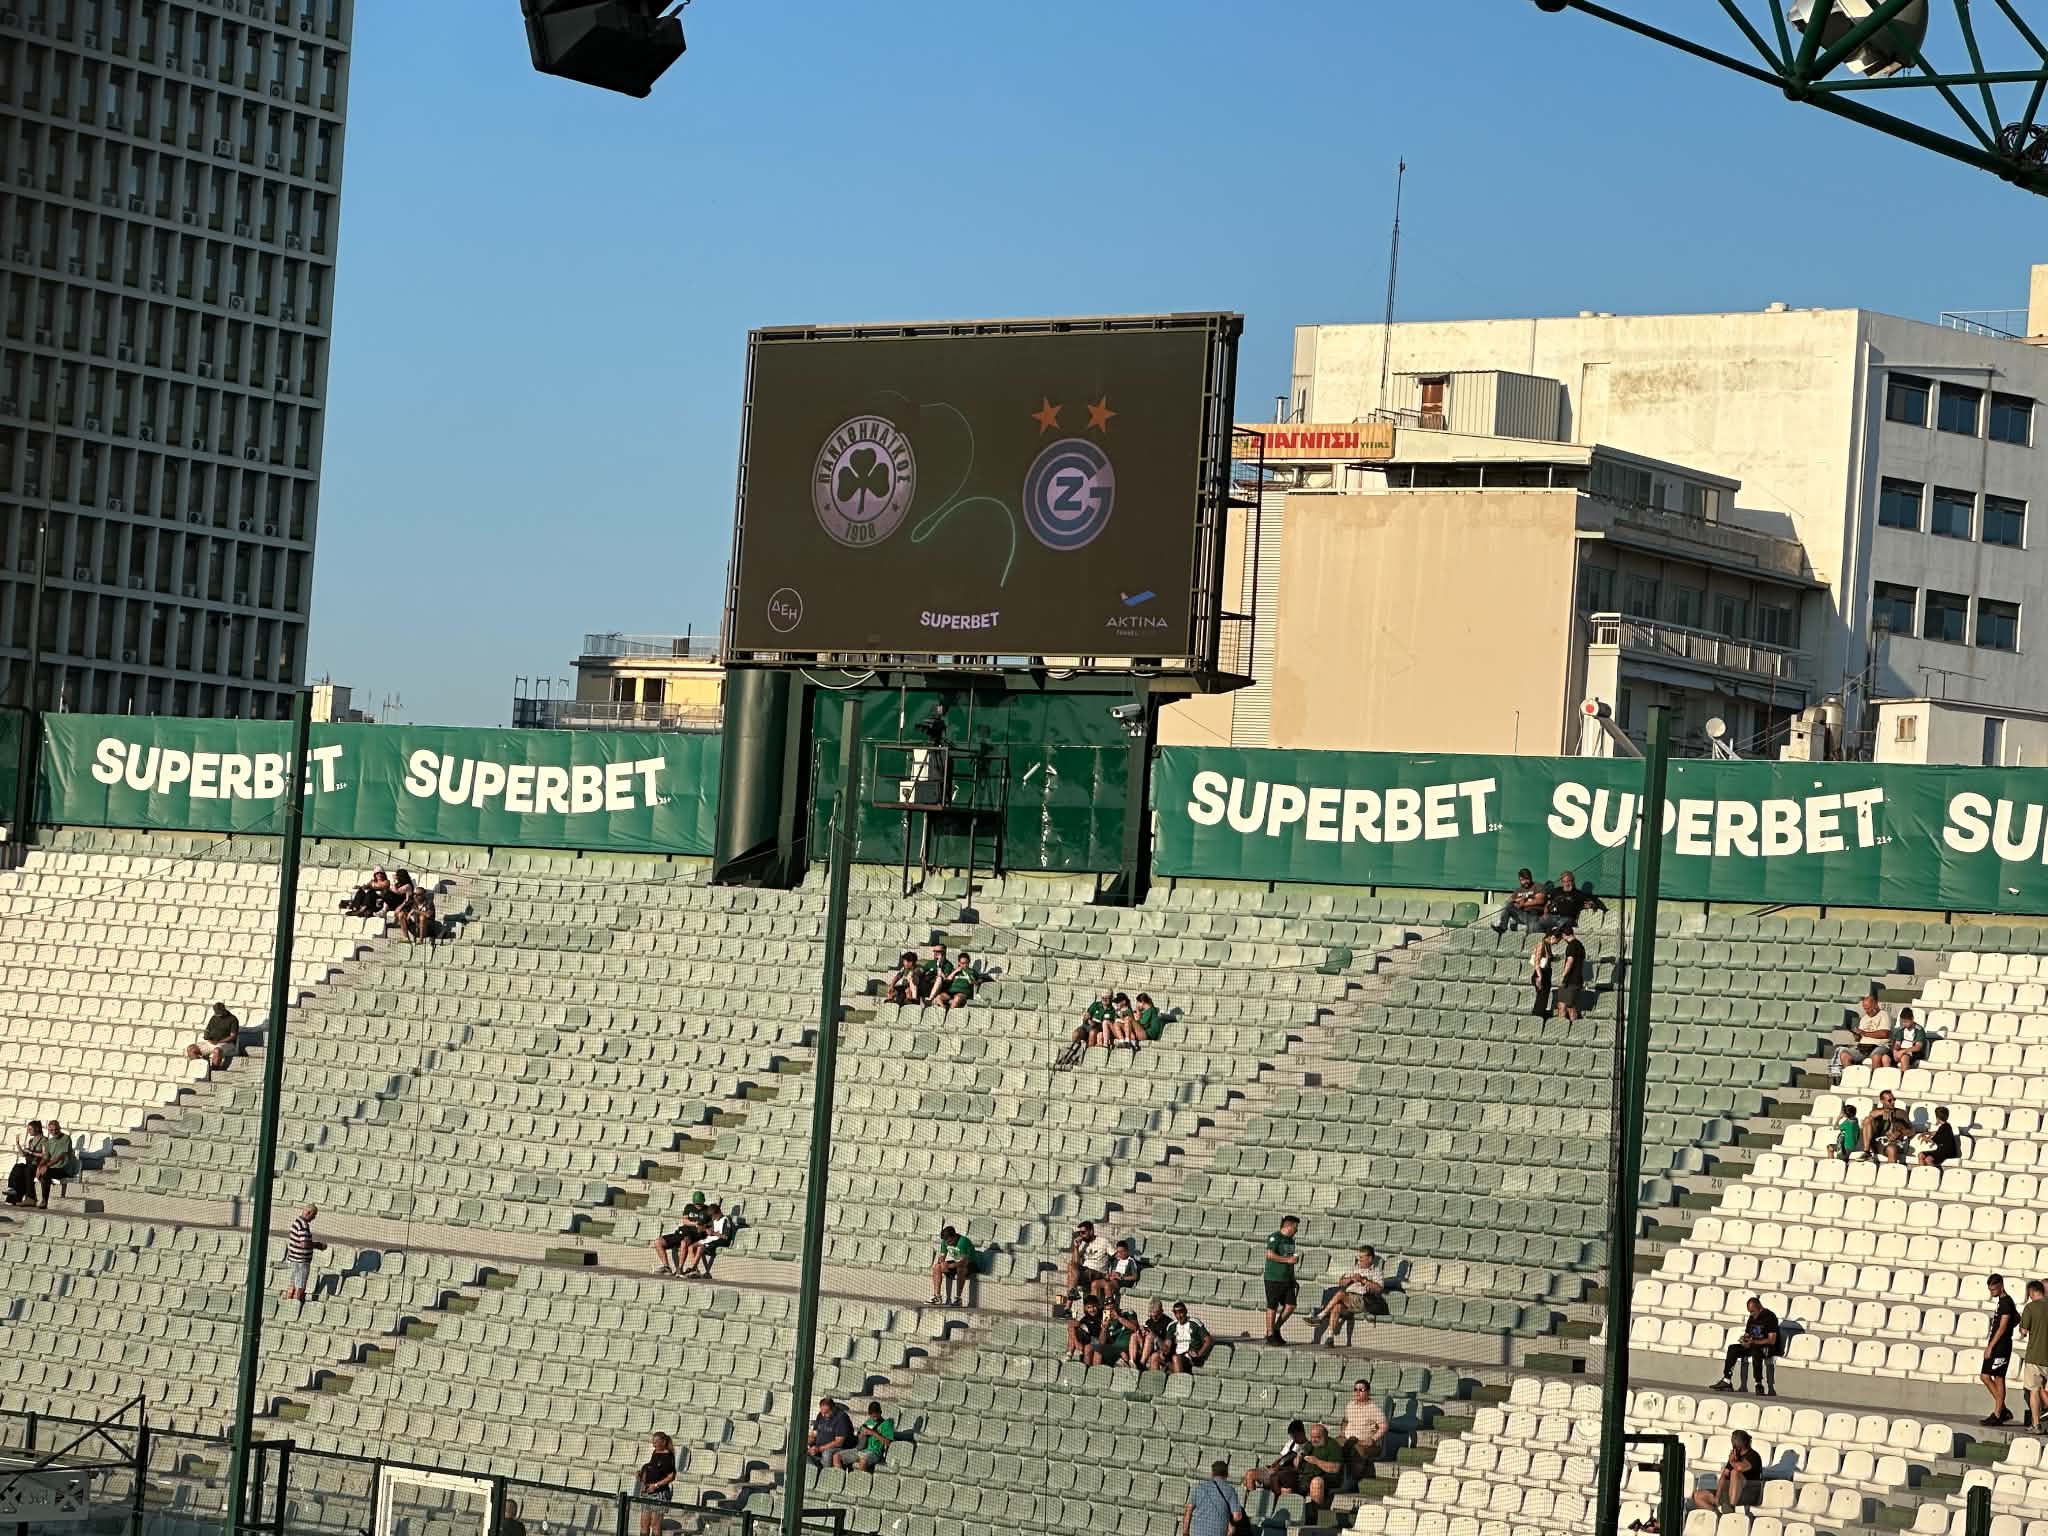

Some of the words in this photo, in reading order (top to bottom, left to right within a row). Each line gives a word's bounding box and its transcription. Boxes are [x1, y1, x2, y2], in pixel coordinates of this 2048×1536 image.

[771, 600, 797, 620] ΔΕΗ
[920, 611, 1000, 630] SUPERBET
[1104, 616, 1168, 628] AKTINA
[405, 749, 666, 814] SUPERBET
[1187, 770, 1497, 843] SUPERBET
[1488, 823, 1504, 833] 21+
[1942, 791, 2048, 865] SU
[1876, 835, 1893, 845] 21+
[1770, 1119, 1782, 1129] 22
[1740, 1149, 1752, 1159] 21
[1711, 1178, 1722, 1189] 20
